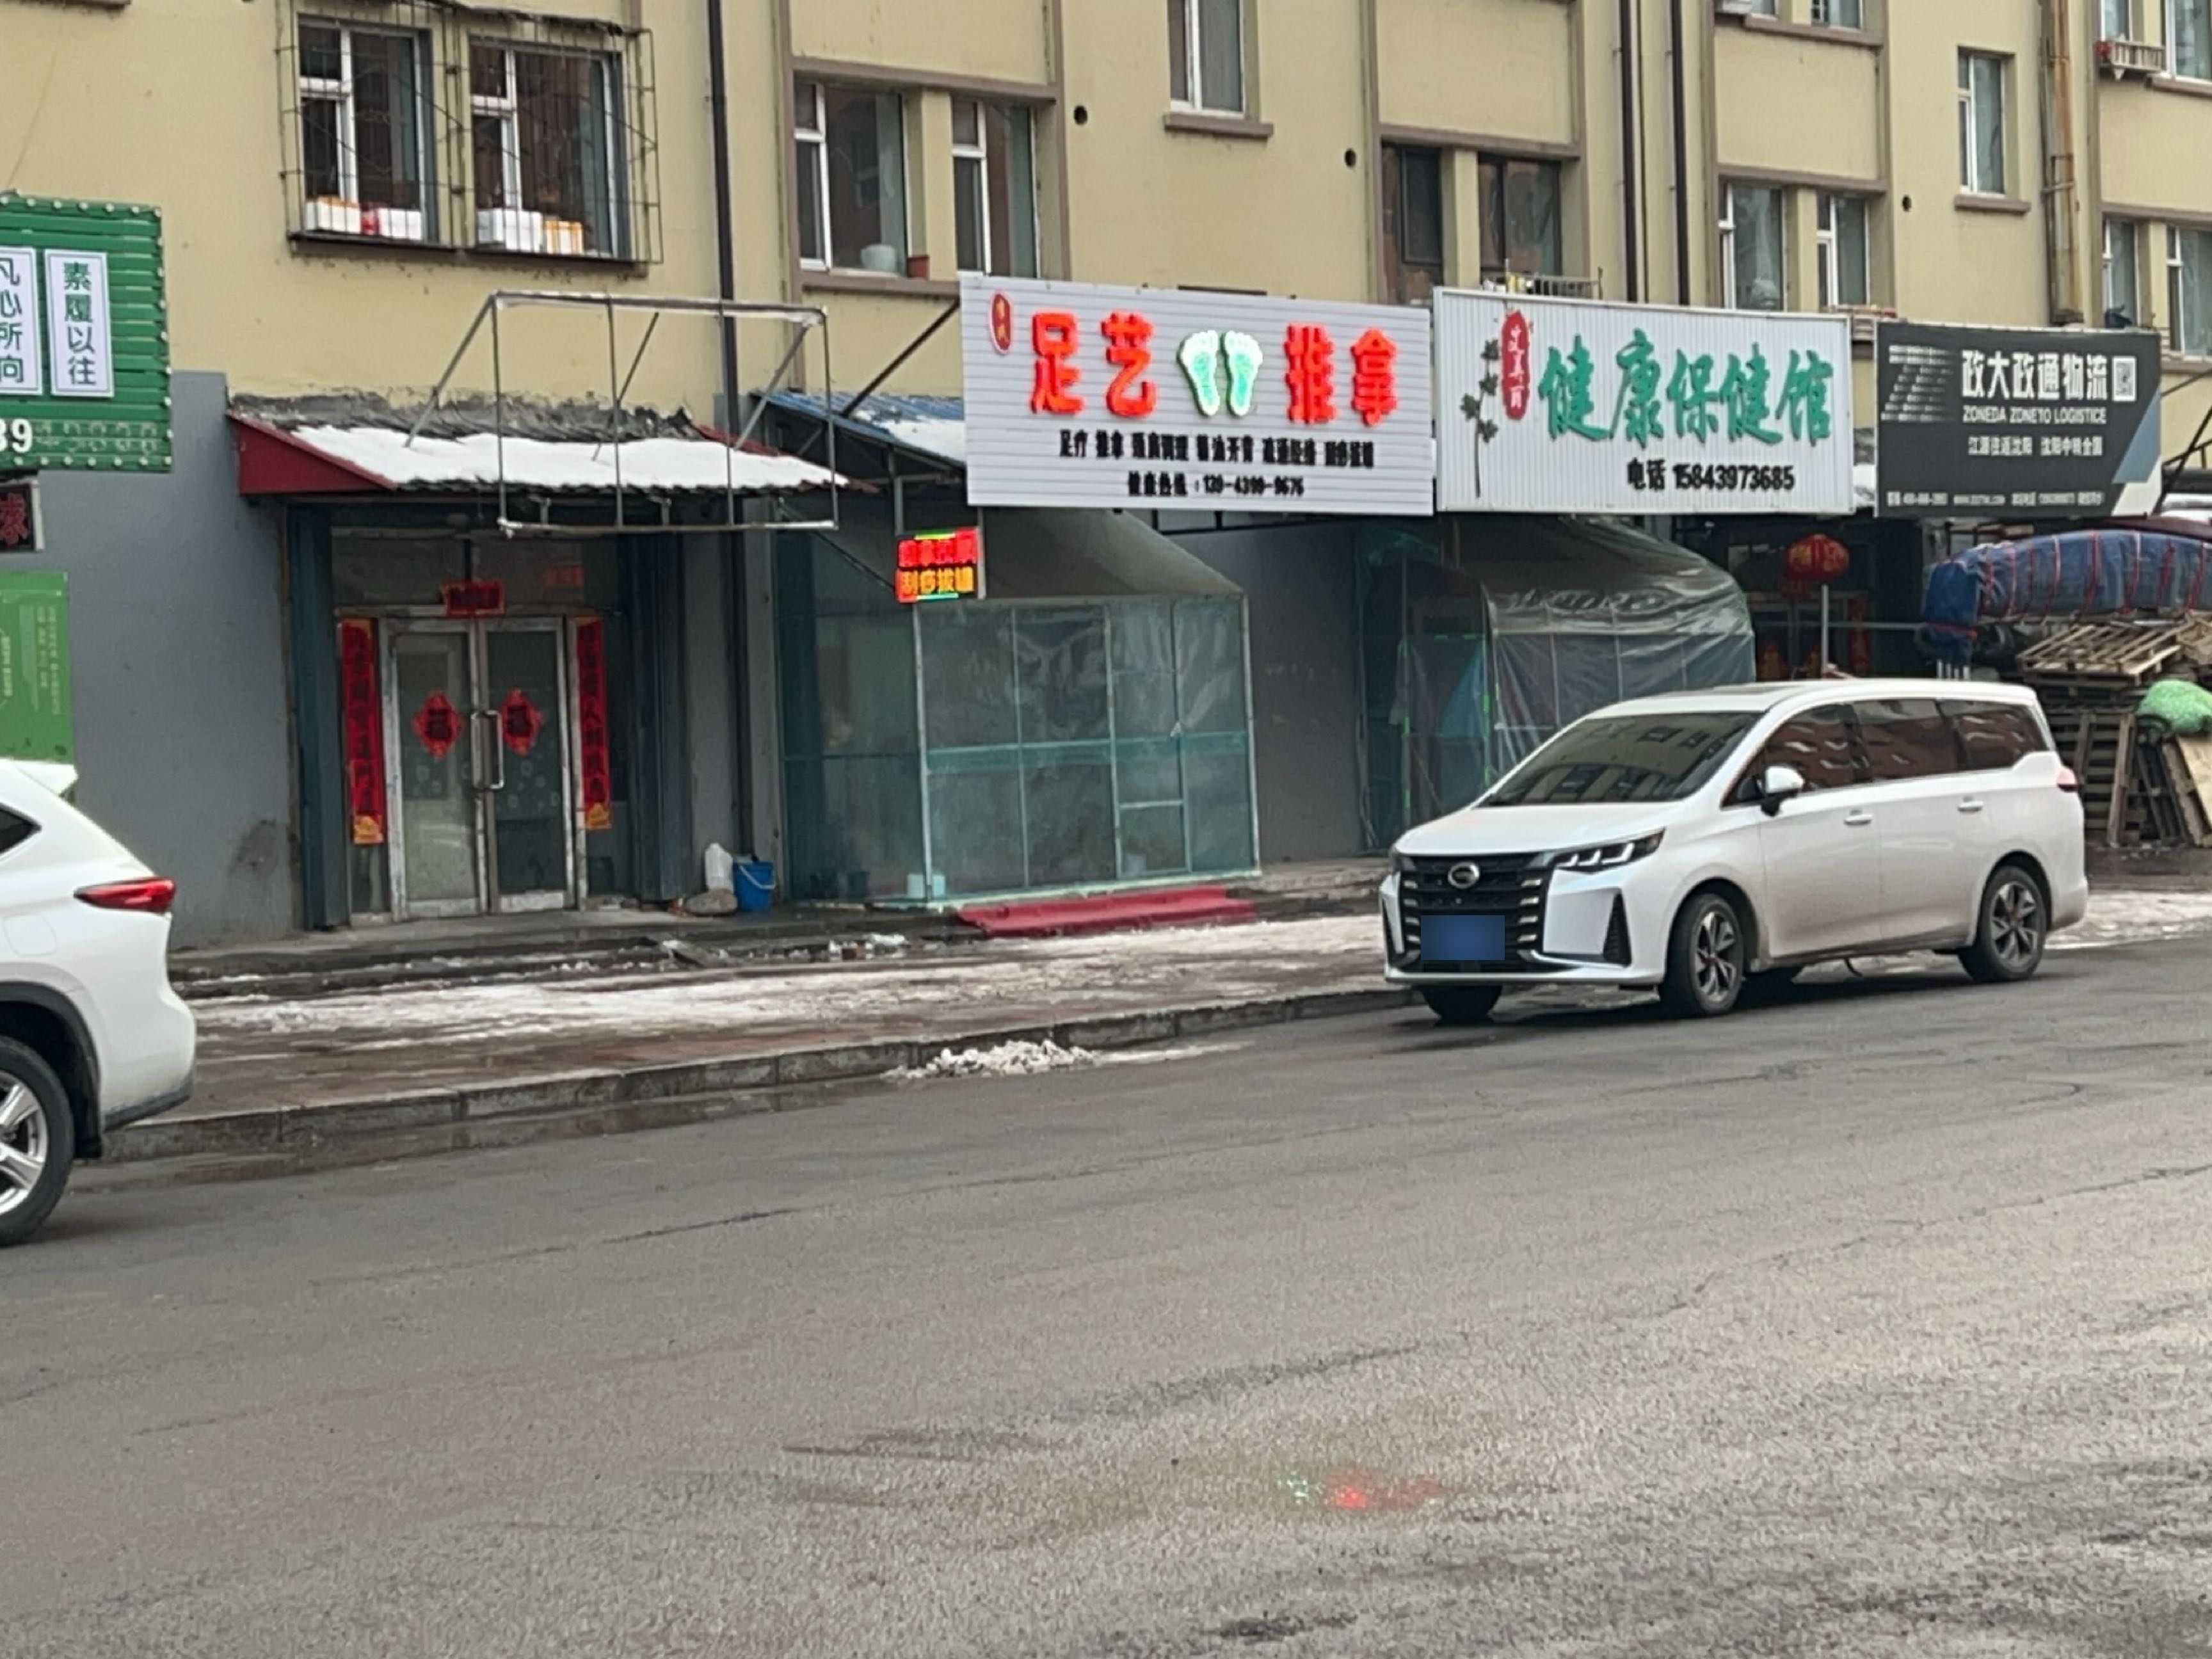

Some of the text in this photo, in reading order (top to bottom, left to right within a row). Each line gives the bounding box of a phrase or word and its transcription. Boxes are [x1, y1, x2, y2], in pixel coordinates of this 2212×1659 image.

[64, 262, 96, 385] 素履以往
[1030, 311, 1158, 416] 足艺
[1284, 322, 1397, 428] 推拿
[1962, 349, 2108, 401] 政大政通物流
[1537, 328, 1834, 450] 健康保健馆
[1627, 457, 1795, 492] 电话 15843973685
